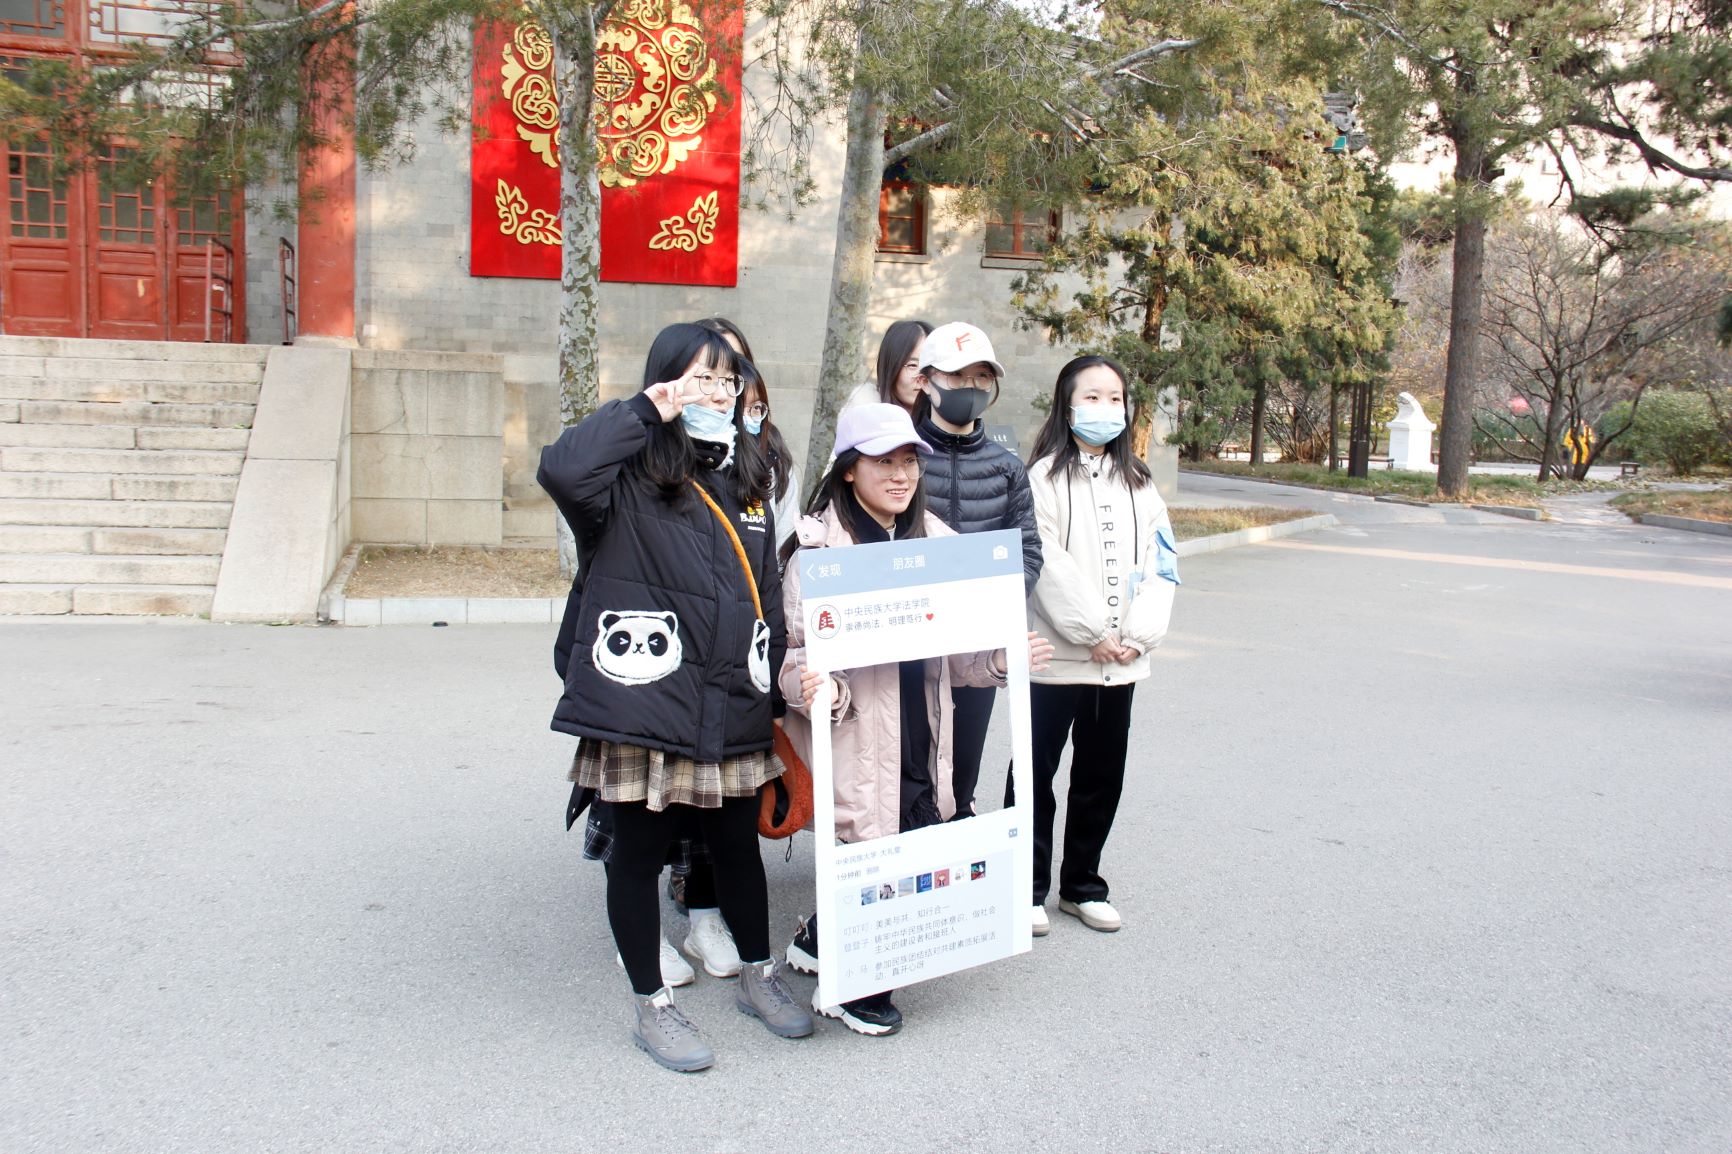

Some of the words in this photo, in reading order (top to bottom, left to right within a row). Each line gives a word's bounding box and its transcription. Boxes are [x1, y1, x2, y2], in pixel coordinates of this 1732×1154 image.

[956, 332, 971, 351] F
[818, 563, 842, 578] 发现
[893, 555, 926, 570] 朋友圈
[844, 597, 930, 617] 中央民族大学法学院
